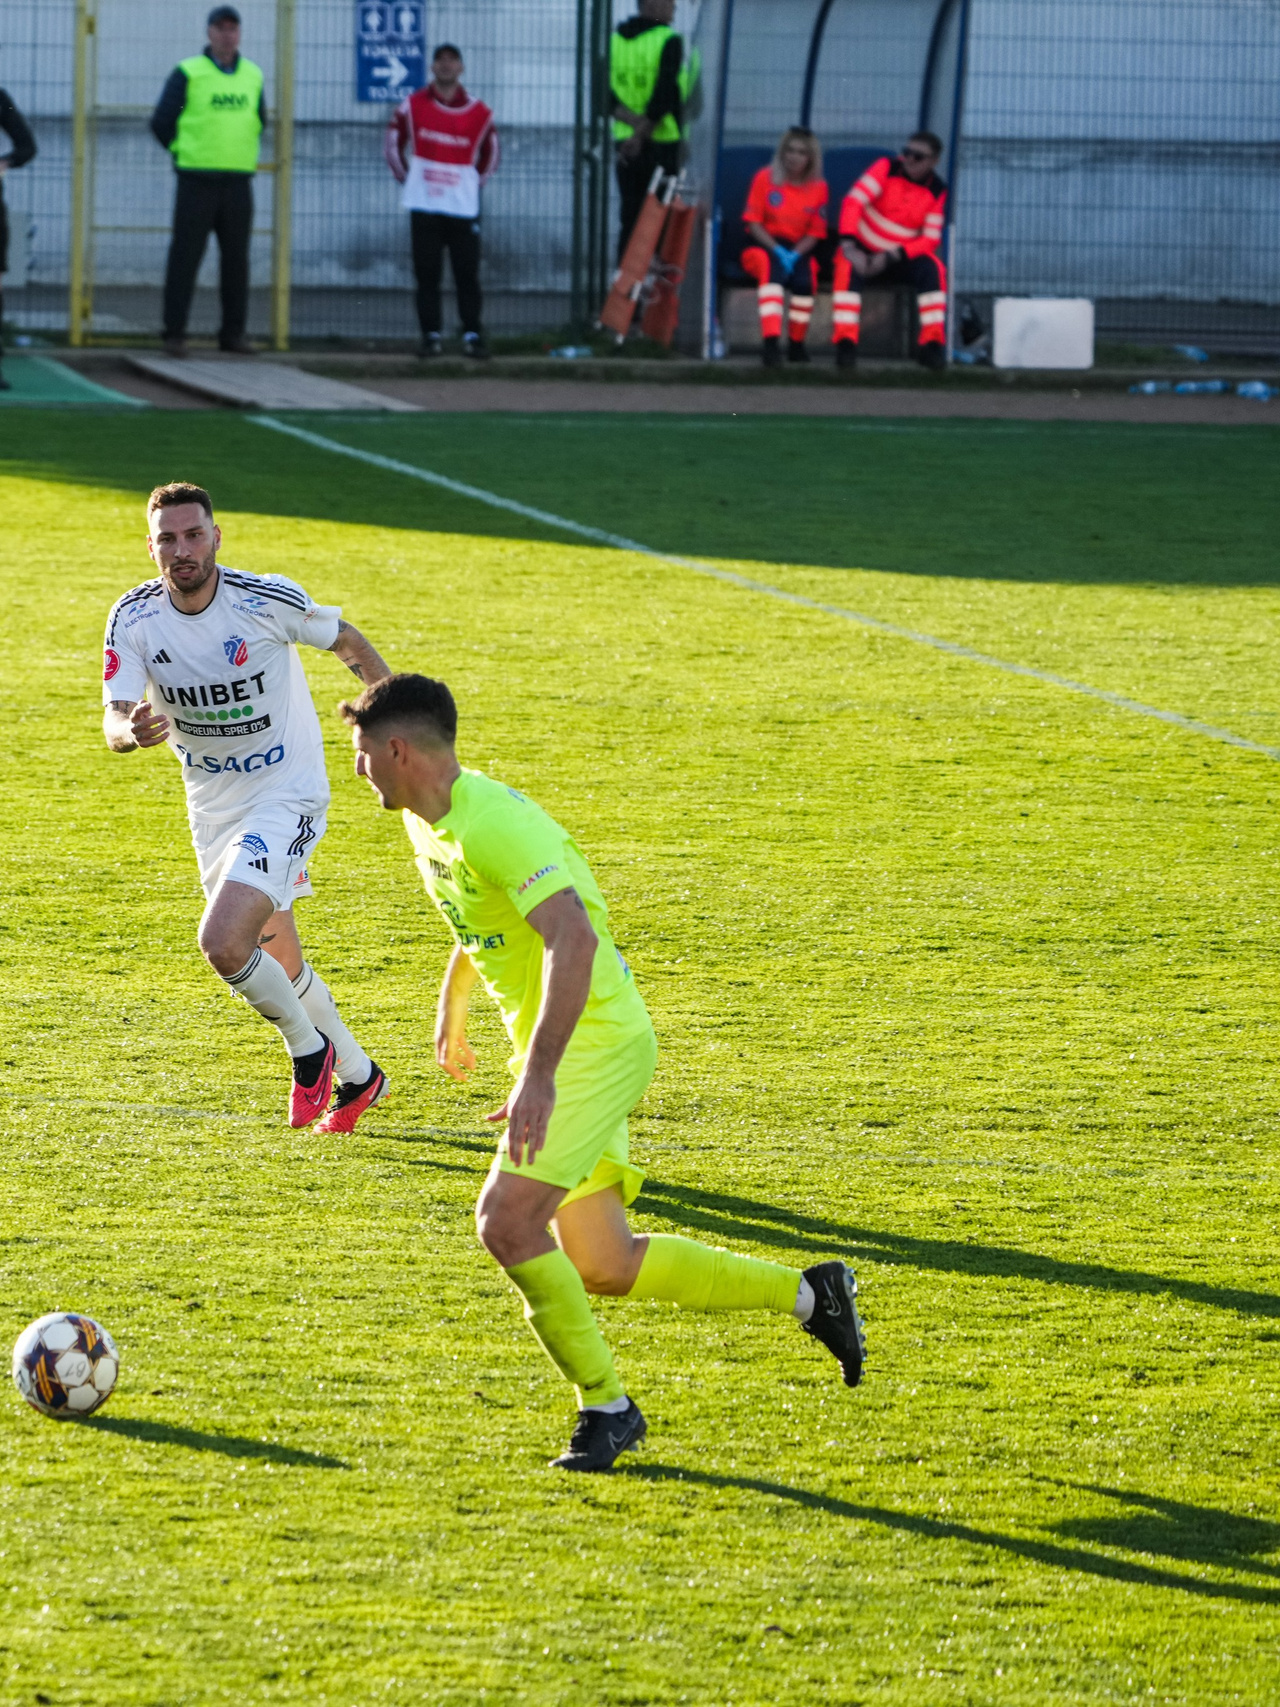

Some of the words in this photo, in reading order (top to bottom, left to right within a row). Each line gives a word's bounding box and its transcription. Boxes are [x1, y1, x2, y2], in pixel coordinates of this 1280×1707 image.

[158, 670, 266, 708] UNIBET
[224, 725, 250, 736] SPRE
[250, 720, 267, 732] 0%
